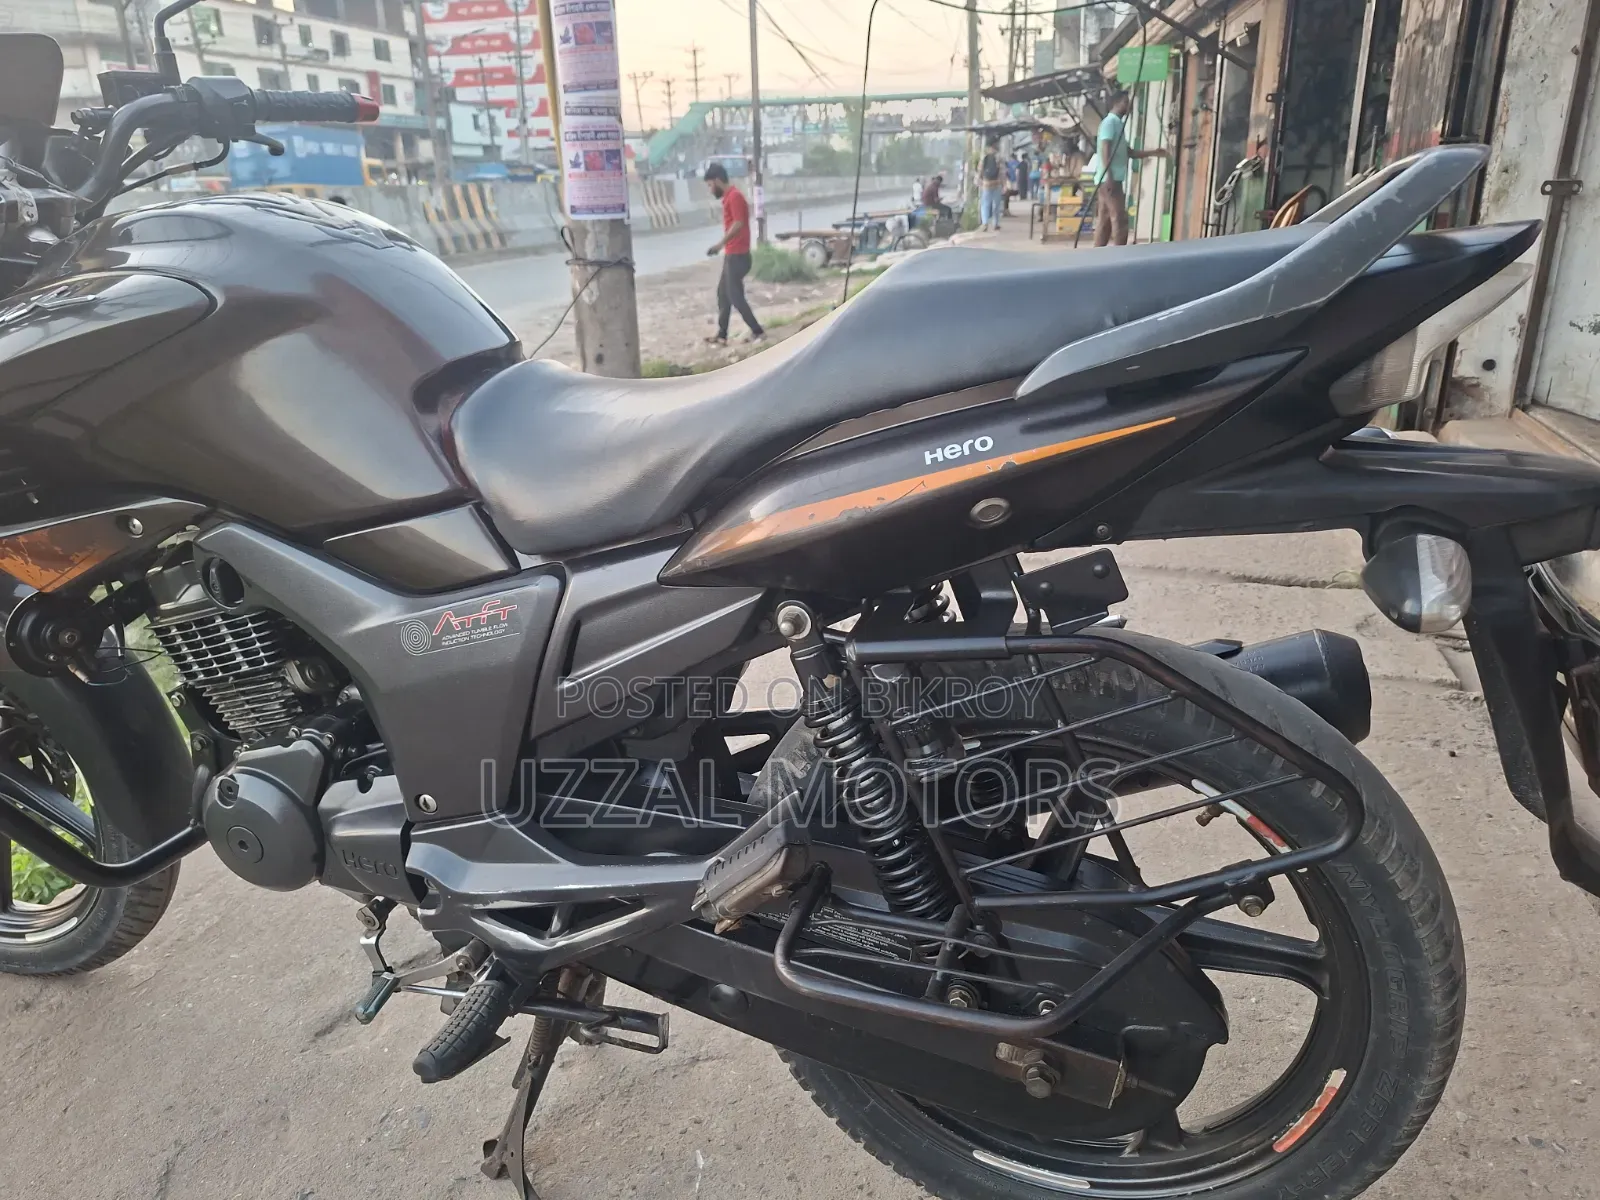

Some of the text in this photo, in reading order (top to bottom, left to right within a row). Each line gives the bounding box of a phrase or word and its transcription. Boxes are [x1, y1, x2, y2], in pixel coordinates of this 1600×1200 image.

[924, 435, 994, 466] Hero
[442, 622, 508, 641] ADVANCED TUMBLE FLOW
[442, 628, 506, 646] INDUCTION TECHNOLOGY
[342, 850, 399, 880] Hero
